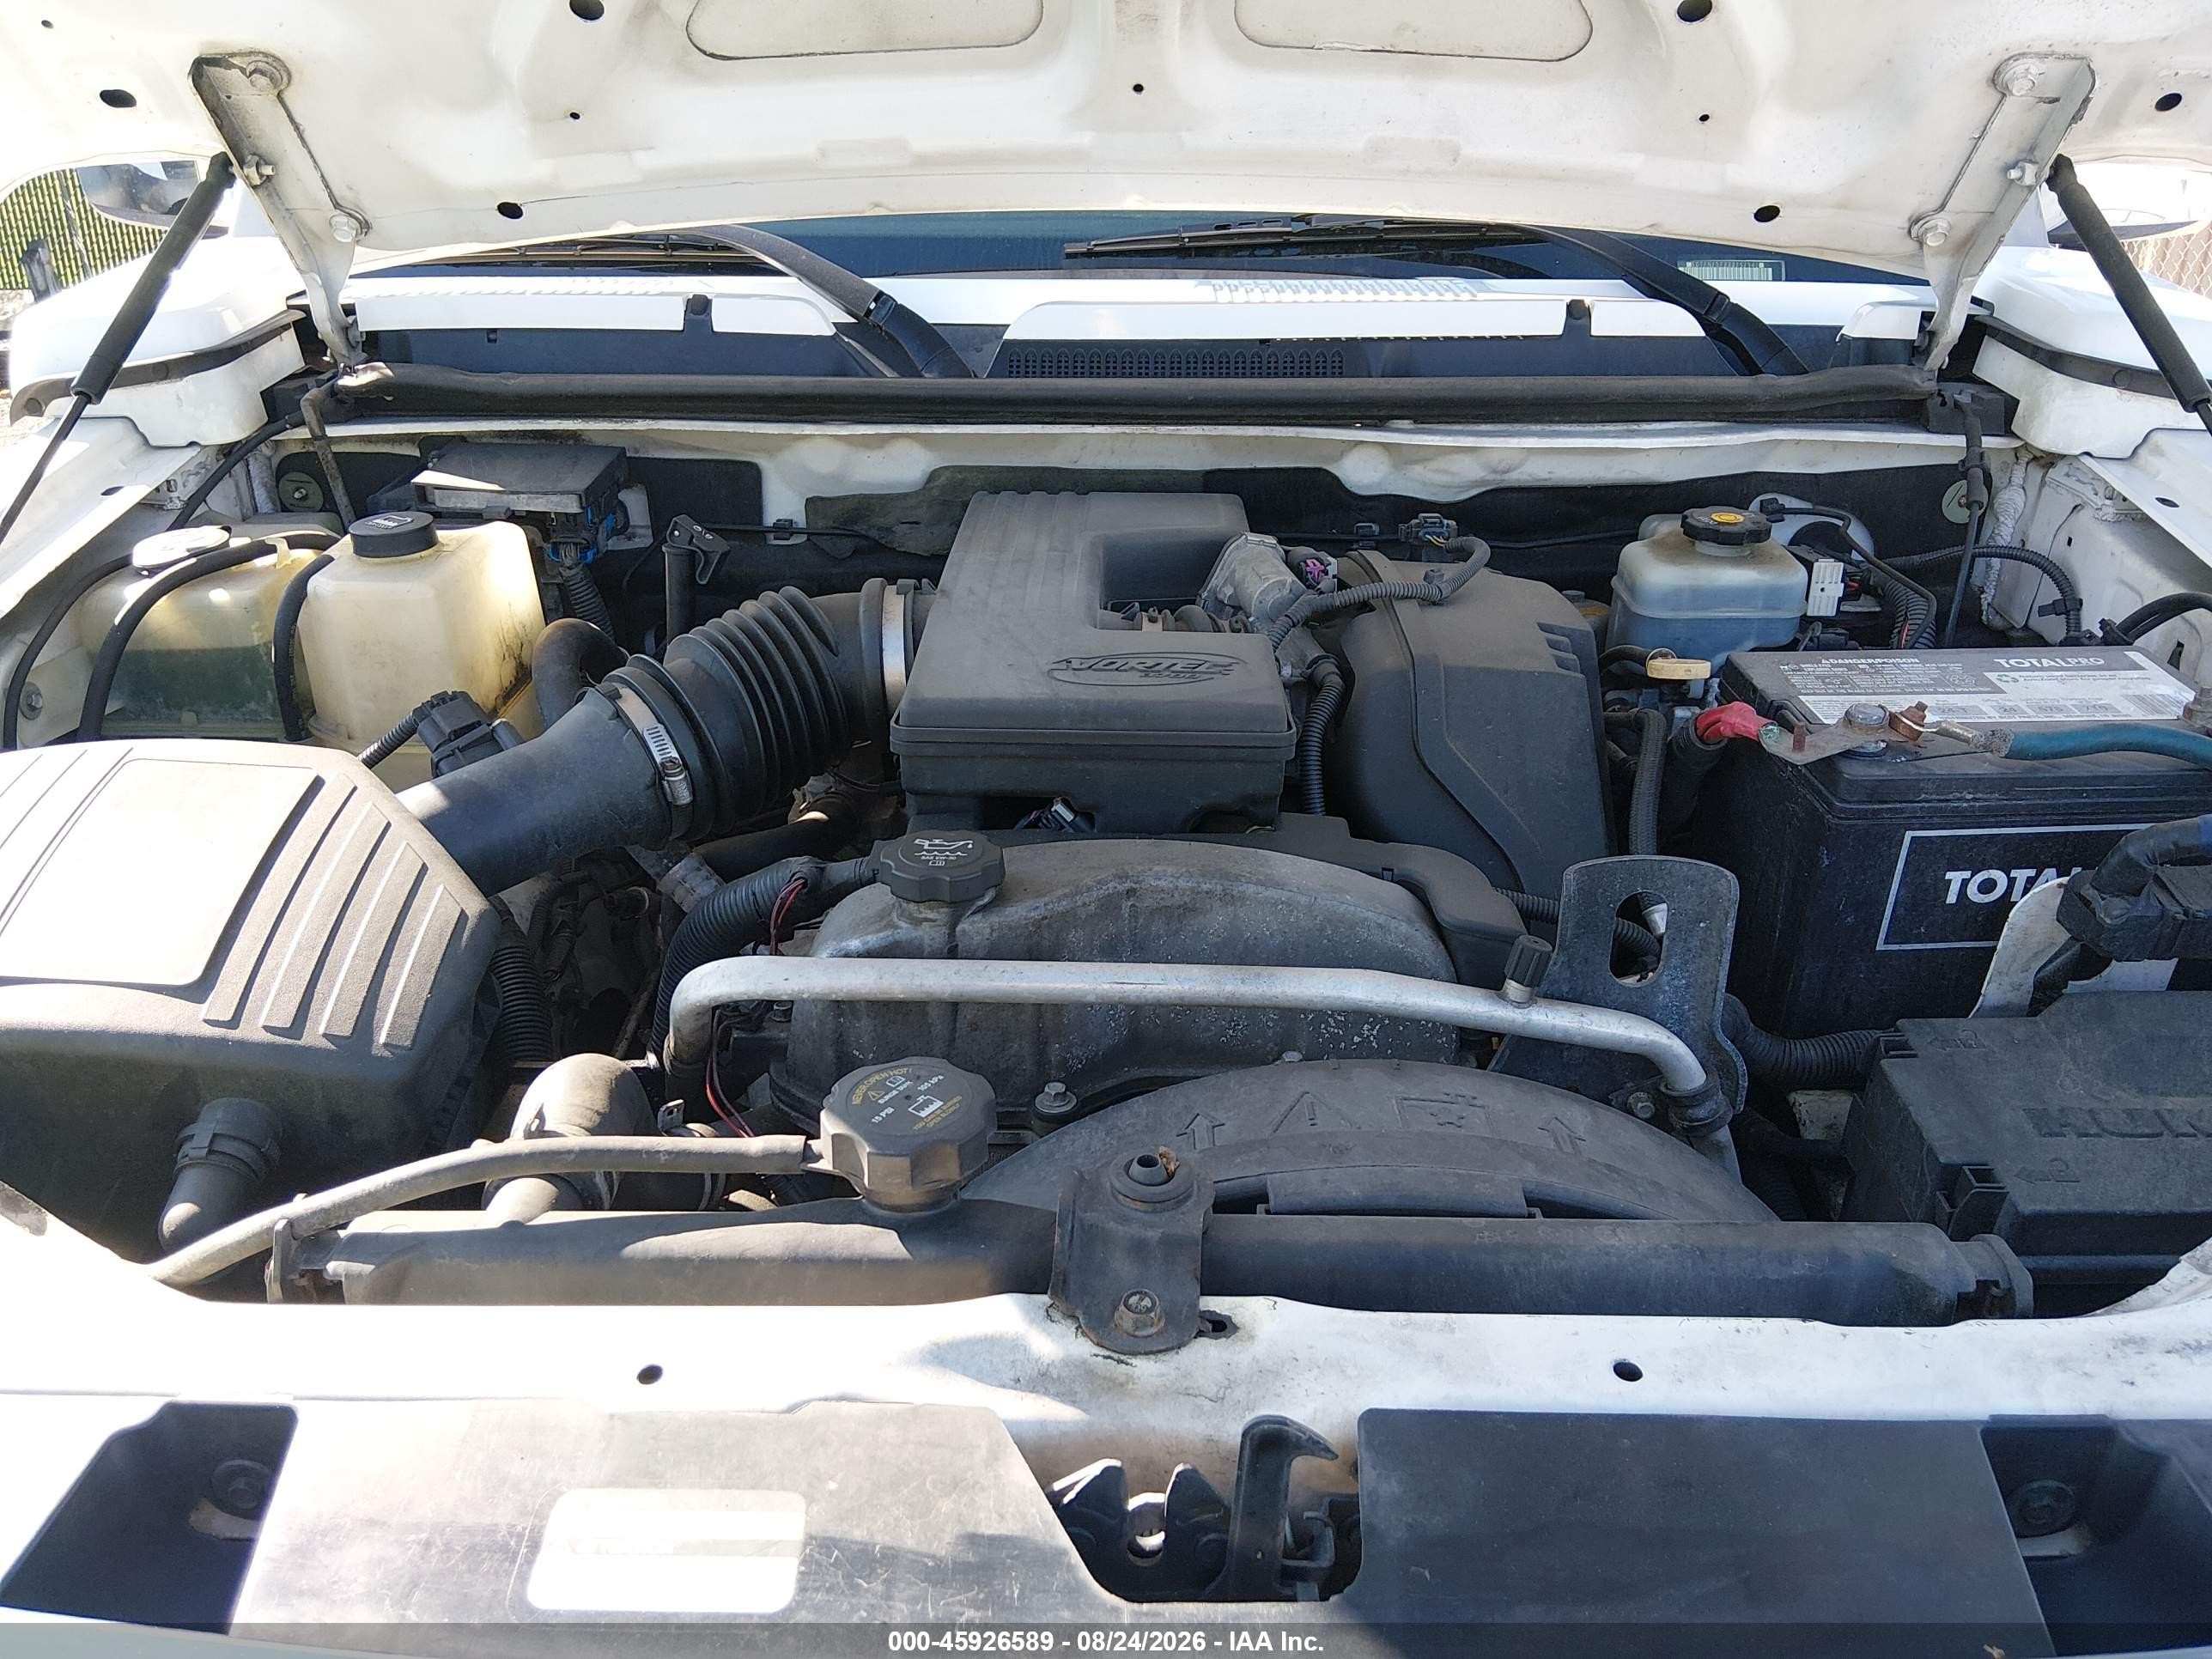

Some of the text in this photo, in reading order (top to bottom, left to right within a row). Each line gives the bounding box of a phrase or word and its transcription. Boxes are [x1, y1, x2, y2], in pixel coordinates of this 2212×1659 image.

[1993, 658, 2106, 668] TOTALPRO
[1944, 866, 2082, 904] TOTA
[851, 1085, 870, 1105] NEVER
[864, 1072, 890, 1085] OPEN
[871, 1106, 896, 1124] 15 PSI
